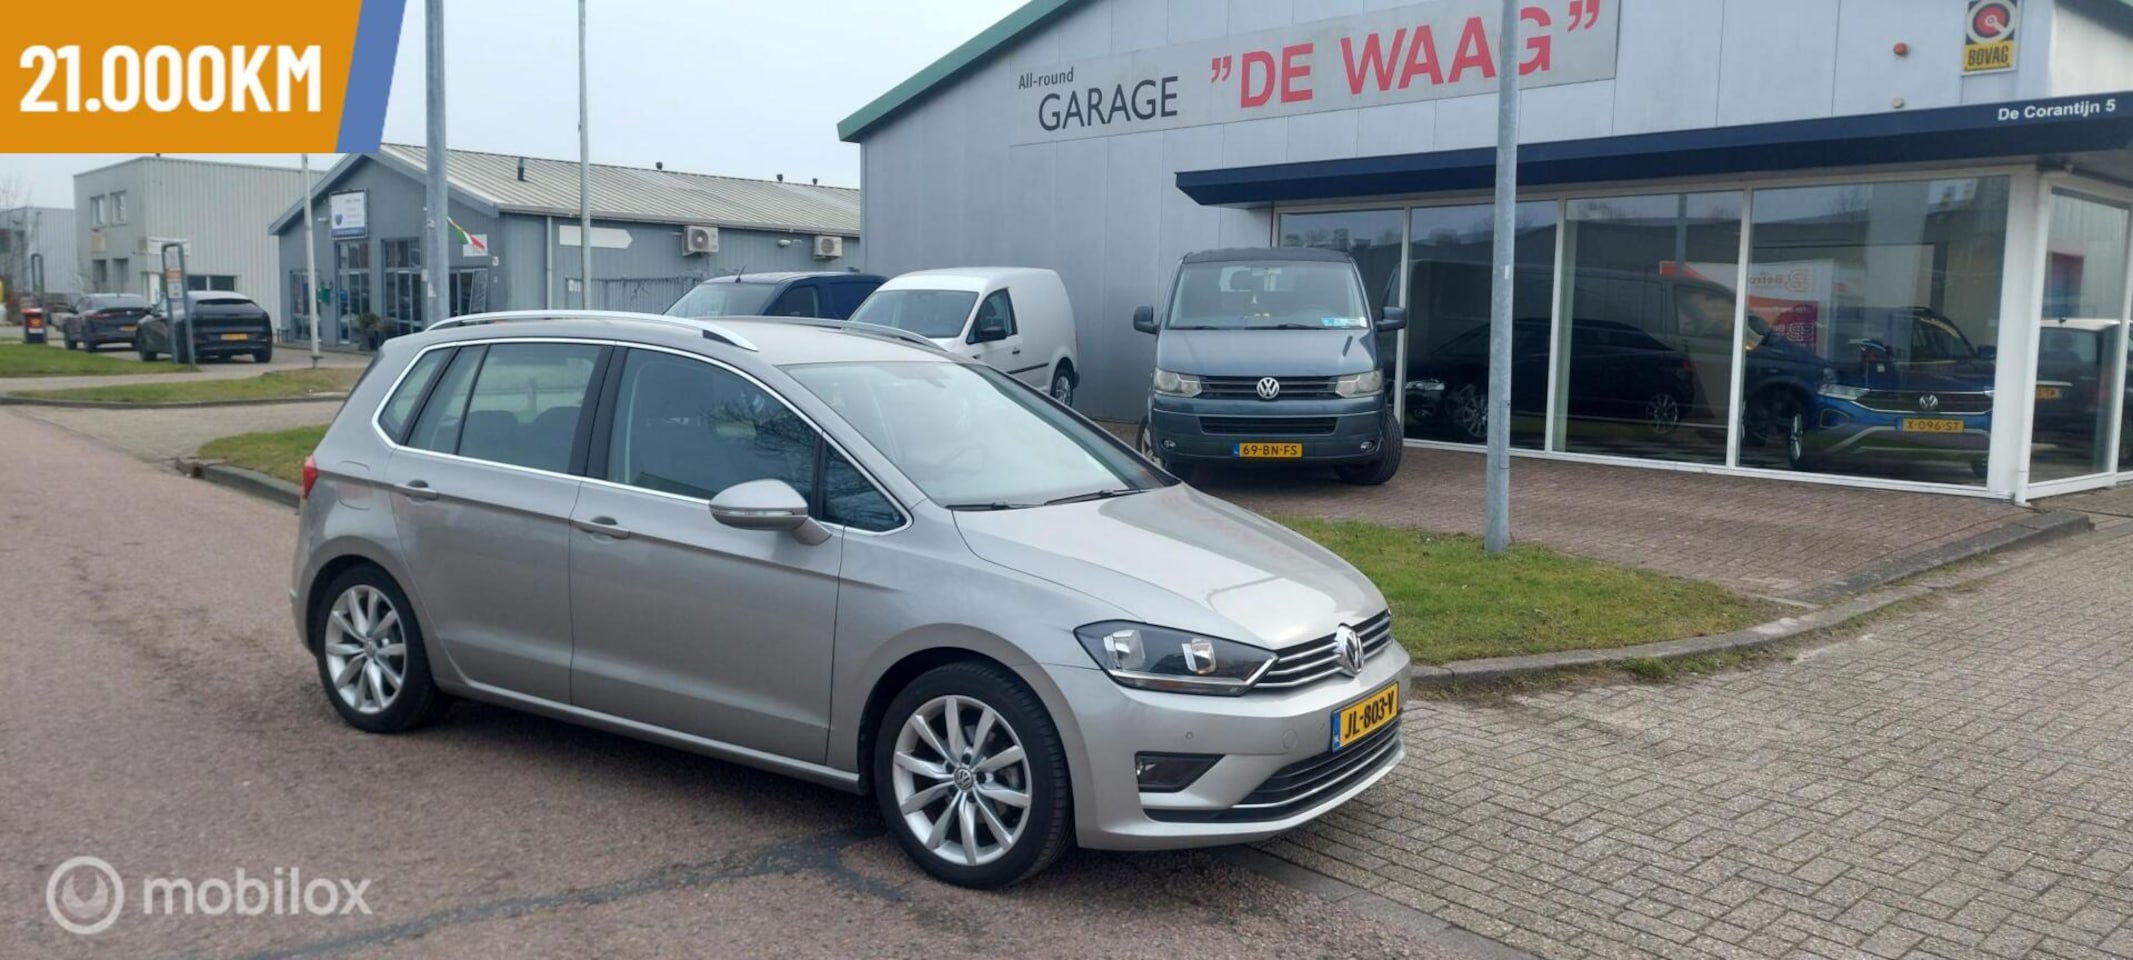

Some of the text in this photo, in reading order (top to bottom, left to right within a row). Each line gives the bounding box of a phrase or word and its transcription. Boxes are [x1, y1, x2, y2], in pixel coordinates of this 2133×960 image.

[1967, 46, 2009, 66] BOVAG
[1018, 66, 1074, 91] All-round
[1038, 75, 1179, 131] GARAGE
[1997, 98, 2117, 121] De Corantijn 5
[1242, 445, 1298, 456] 69-BN-FS
[1344, 690, 1395, 739] JL-803-V
